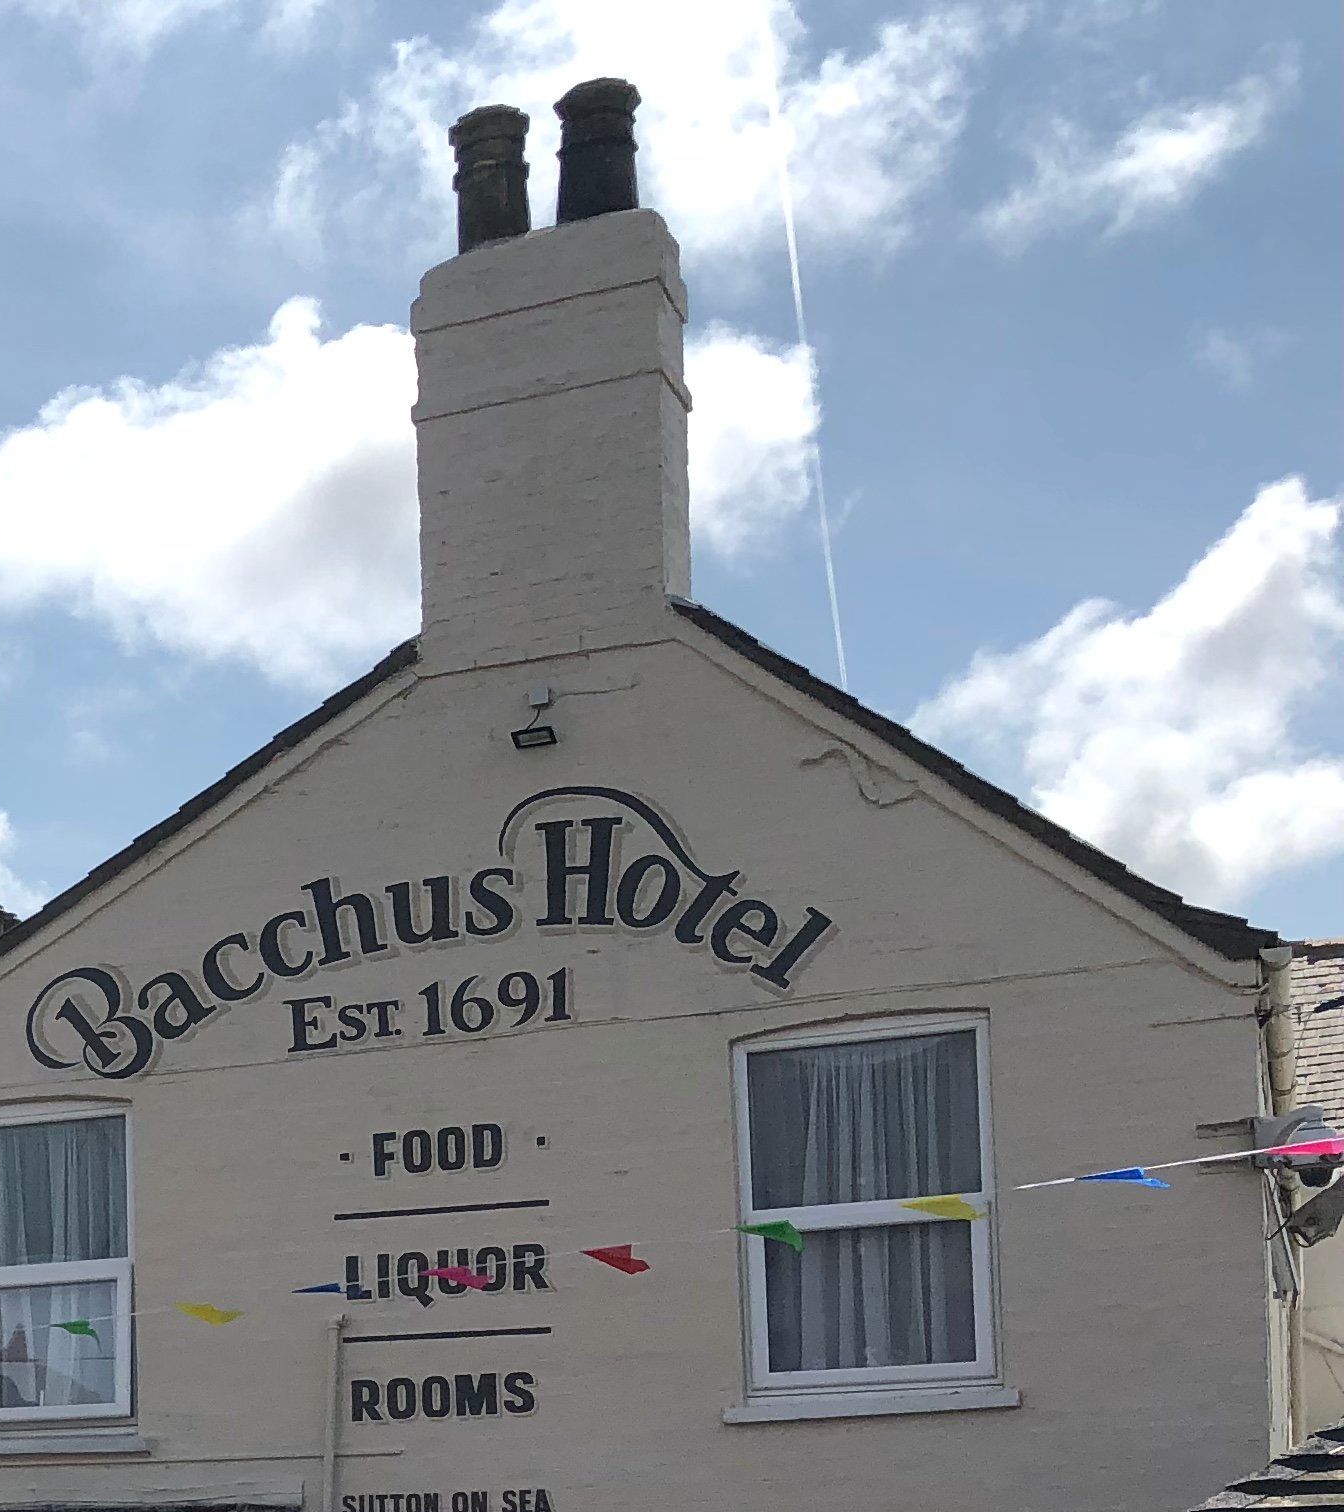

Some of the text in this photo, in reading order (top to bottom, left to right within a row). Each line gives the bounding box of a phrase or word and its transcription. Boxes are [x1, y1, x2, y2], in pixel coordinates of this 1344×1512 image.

[25, 786, 833, 1080] Bacchus Hotel
[417, 966, 572, 1036] 1691
[372, 1123, 503, 1176] FOOD
[345, 1243, 552, 1308] LIQUOR
[350, 1371, 537, 1422] ROOMS
